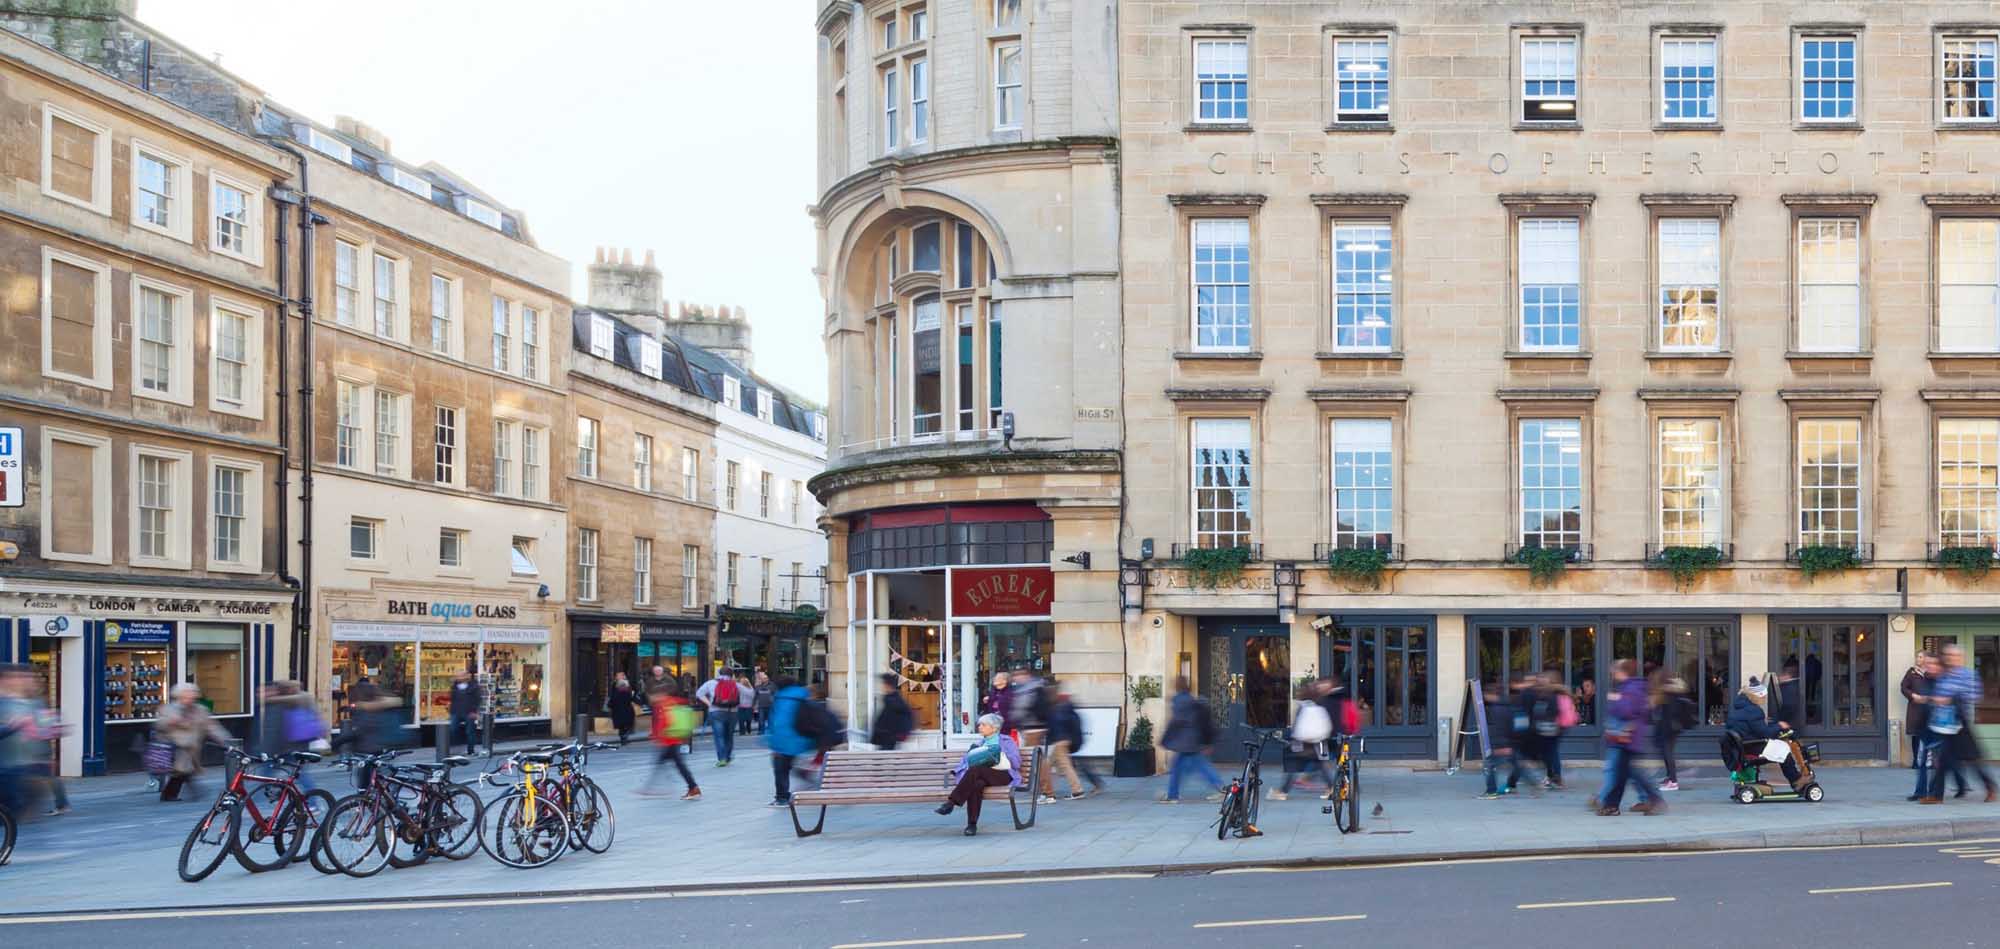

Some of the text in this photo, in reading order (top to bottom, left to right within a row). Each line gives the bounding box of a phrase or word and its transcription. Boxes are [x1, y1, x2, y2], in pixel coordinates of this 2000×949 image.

[1207, 151, 1979, 175] CHRISTOPHER HOTEL
[1078, 408, 1100, 418] HIGH
[965, 574, 1048, 607] EUREKA
[89, 600, 136, 611] LONDON
[156, 602, 200, 613] CAMERA
[388, 600, 517, 622] BATH aqua GLASS
